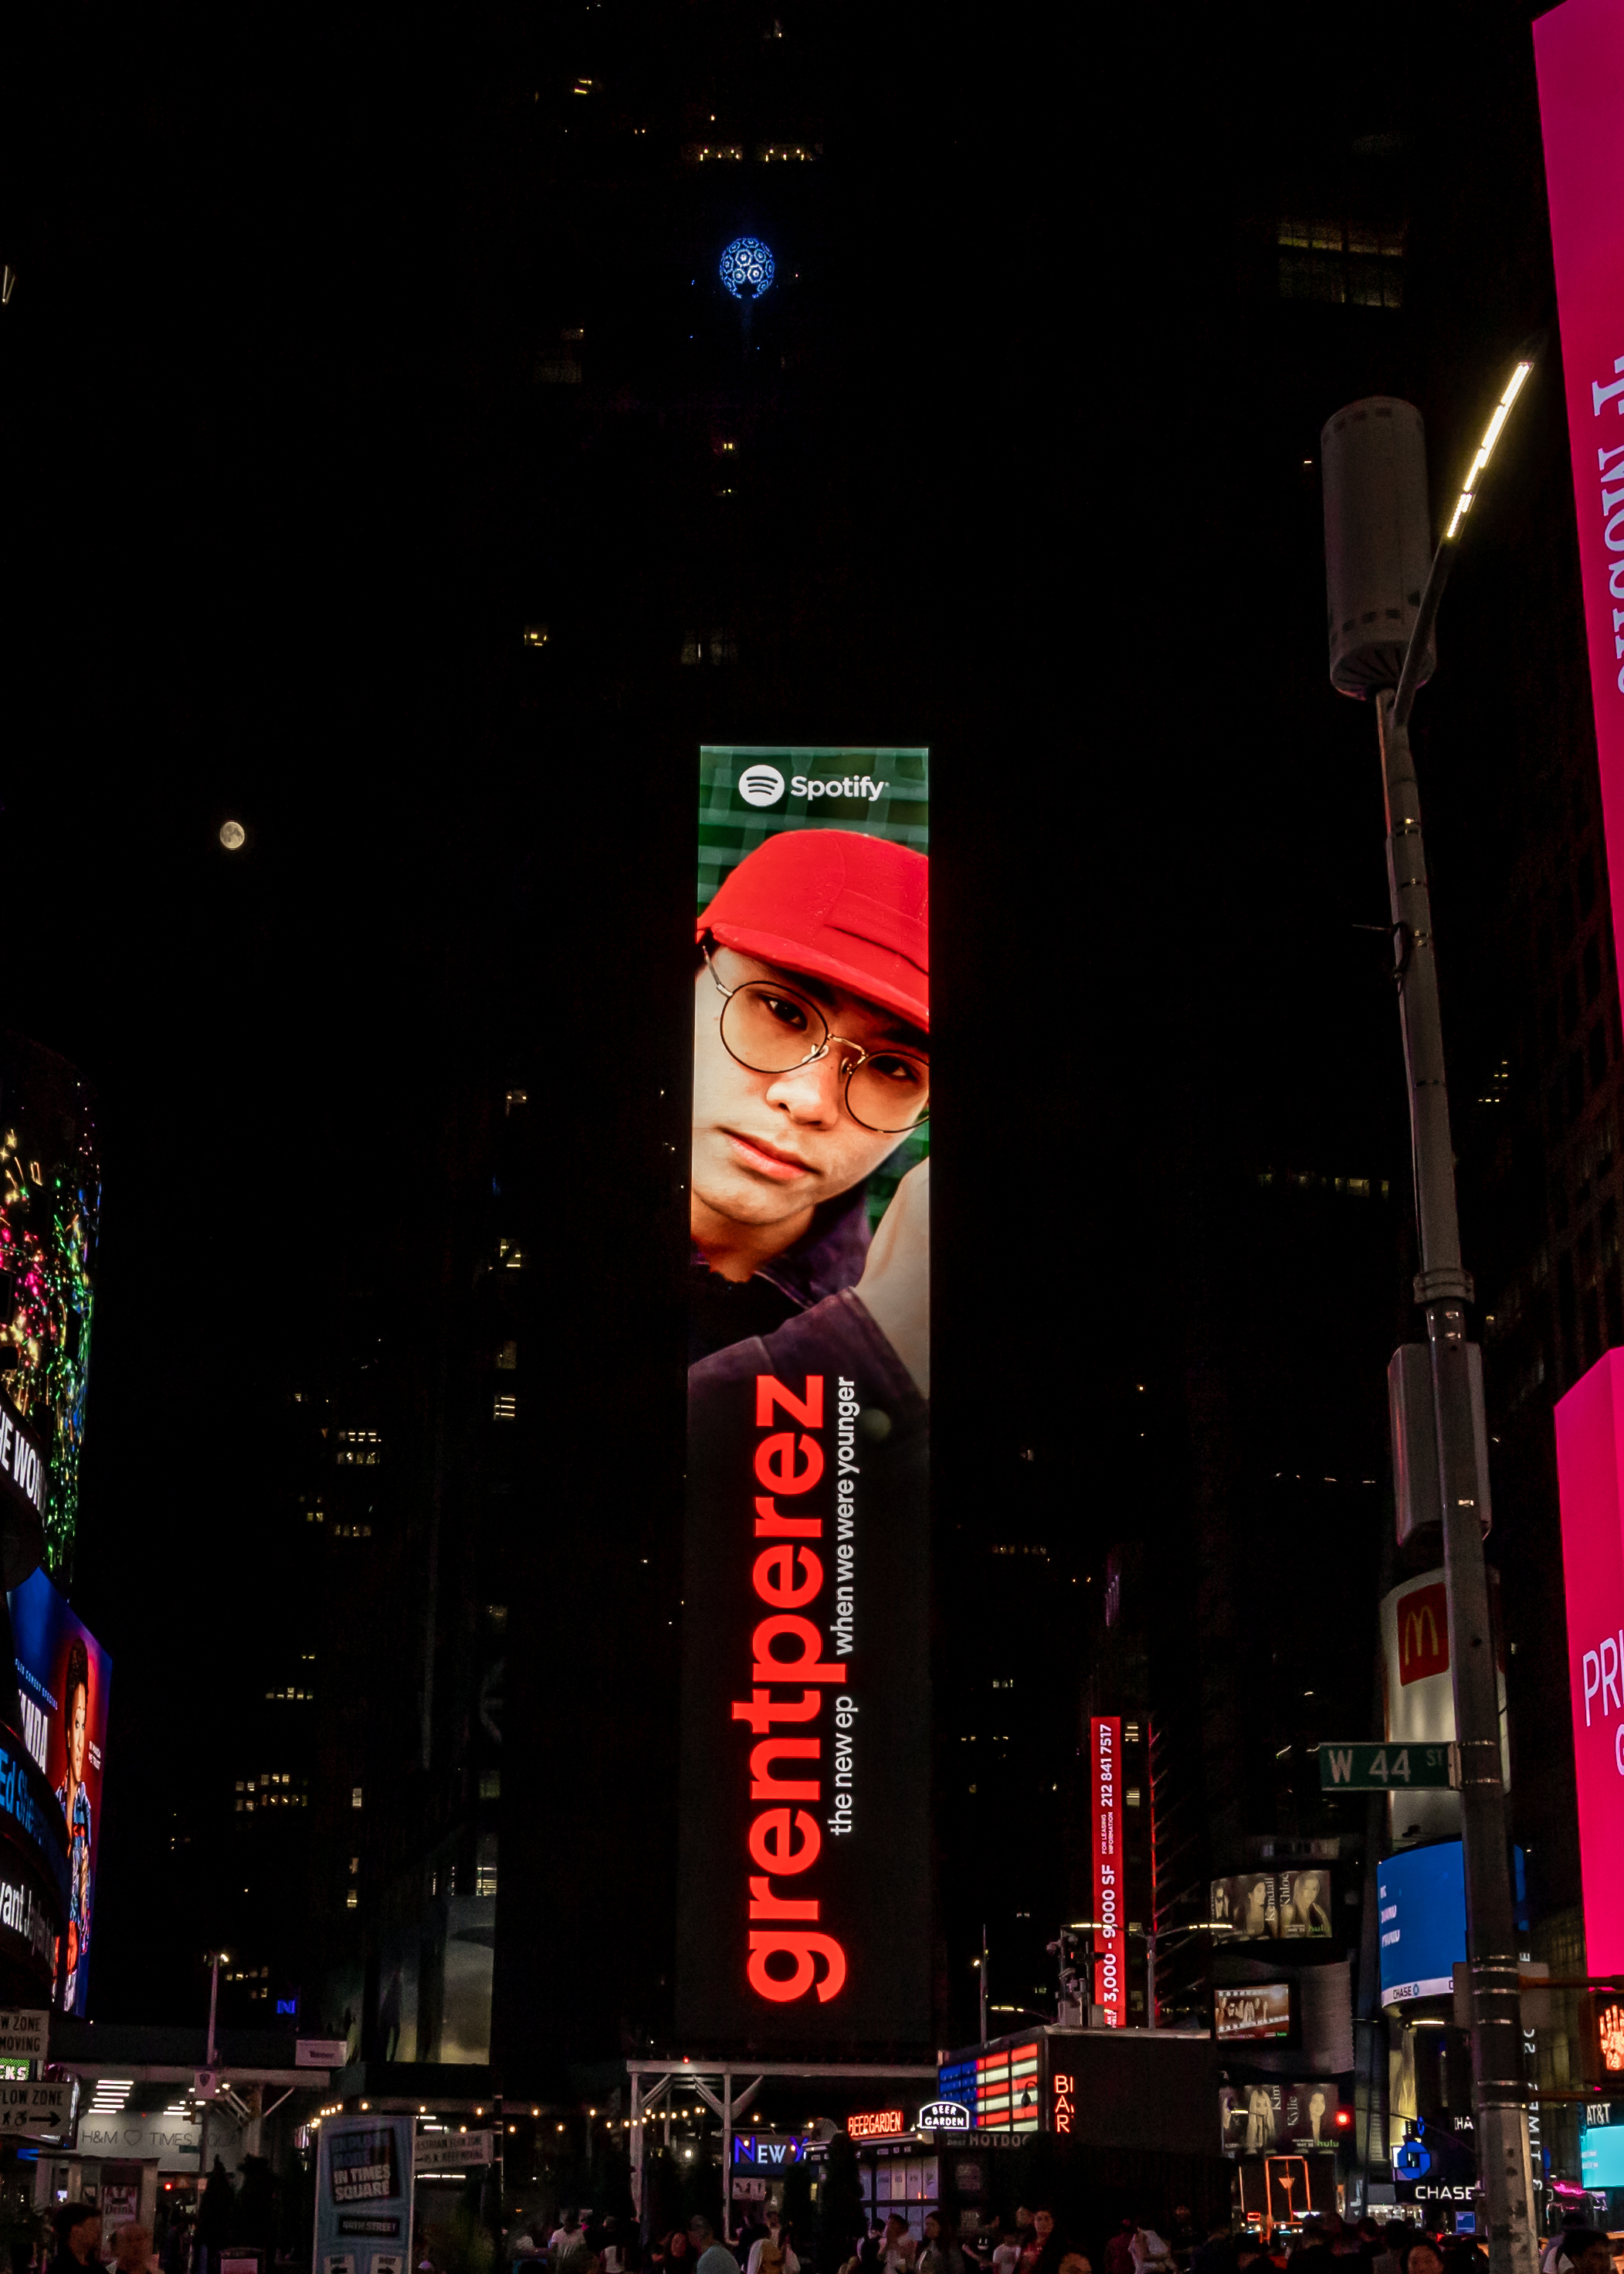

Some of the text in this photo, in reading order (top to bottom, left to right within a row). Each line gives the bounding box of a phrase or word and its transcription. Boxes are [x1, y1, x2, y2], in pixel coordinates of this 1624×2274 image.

[791, 776, 884, 801] Spotify
[828, 1376, 859, 1835] the new ep when we were younger
[732, 1375, 847, 2002] grentperez
[1100, 1723, 1114, 1807] 212 841 7517
[1328, 1750, 1443, 1783] W 44 ST
[1101, 1865, 1115, 1885] SF
[1264, 1877, 1274, 1921] Kendall
[1101, 1889, 1119, 1939] 9,000
[1103, 1953, 1120, 2003] 3,000
[1393, 1986, 1412, 2000] CHASE
[13, 2016, 41, 2031] ZONE
[32, 2089, 63, 2106] ZONE
[1271, 2085, 1281, 2110] Kim
[924, 2116, 965, 2126] GARDEN
[932, 2105, 958, 2116] BEER
[1287, 2096, 1298, 2126] Kylie
[1587, 2103, 1611, 2126] AT&T
[82, 2130, 117, 2143] H&M
[150, 2132, 192, 2147] TIMES
[734, 2135, 786, 2164] NEW
[334, 2164, 392, 2185] IN TIMES
[335, 2180, 390, 2202] SQUARE
[1415, 2186, 1476, 2200] CHASE
